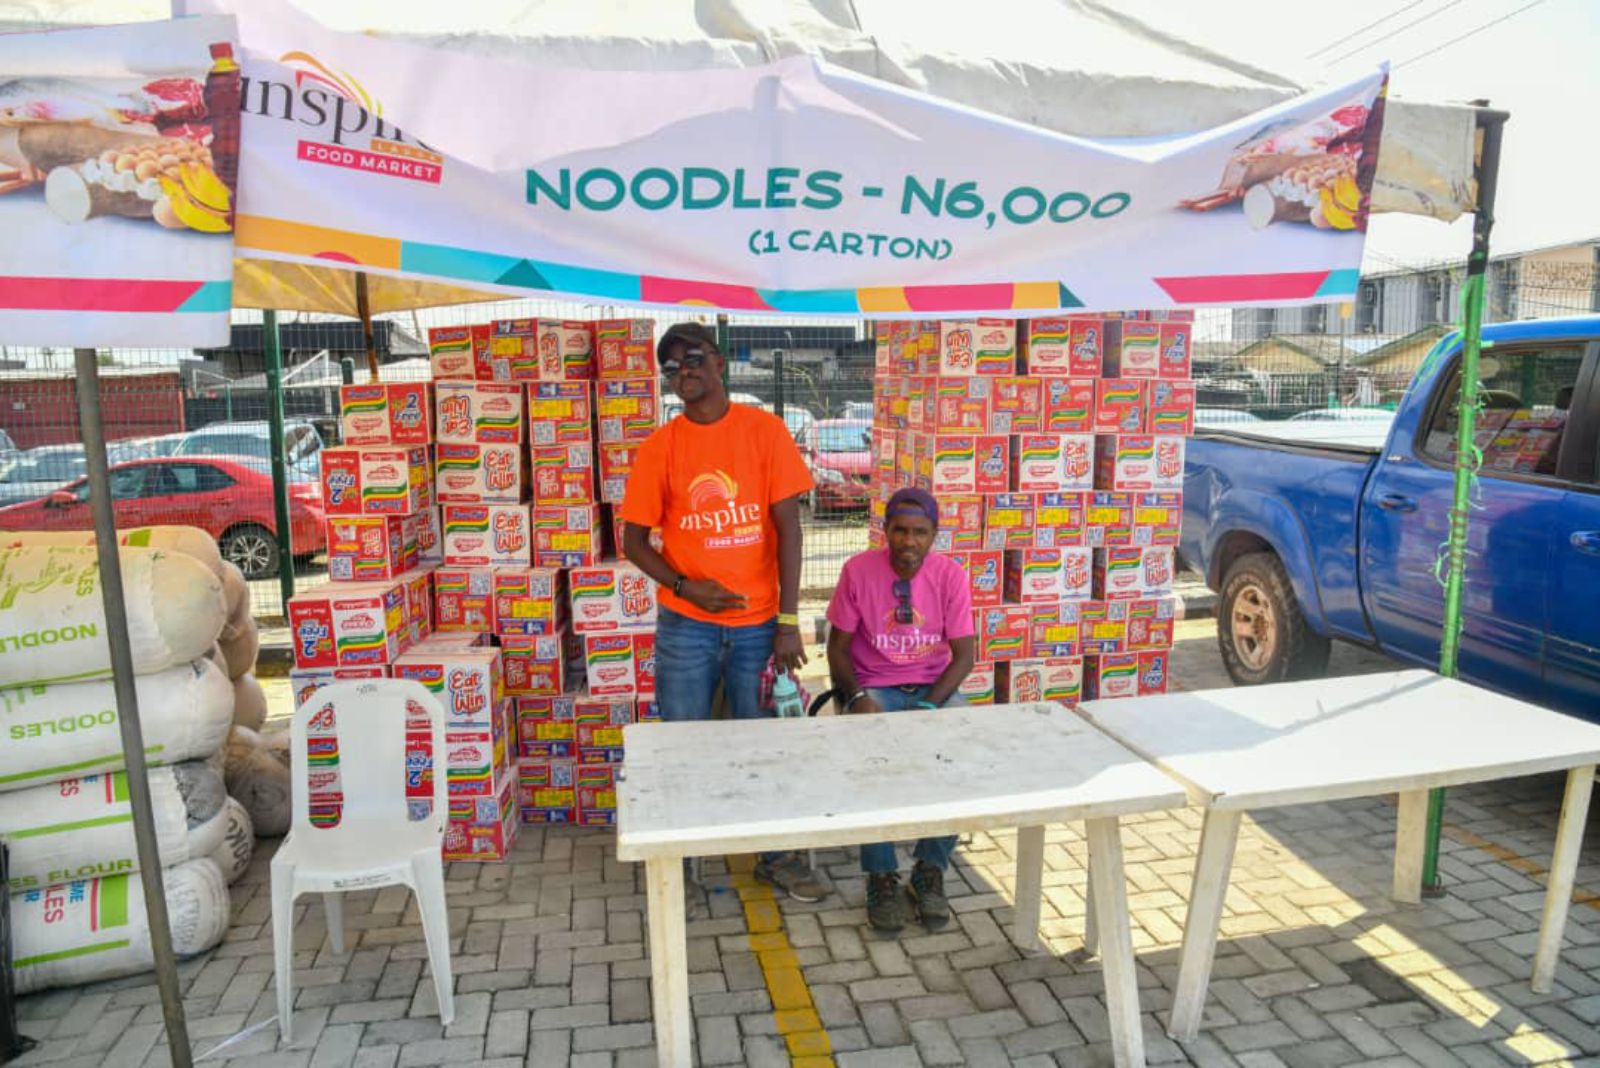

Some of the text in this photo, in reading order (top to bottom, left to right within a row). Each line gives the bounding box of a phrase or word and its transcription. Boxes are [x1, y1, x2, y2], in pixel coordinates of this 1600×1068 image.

[306, 146, 436, 179] FOOD MARKET
[525, 167, 1130, 229] NOODLES - N6,000
[749, 230, 953, 260] (1 CARTON)
[1087, 328, 1096, 344] 2
[1175, 333, 1185, 347] 2
[407, 394, 417, 409] 2
[486, 450, 513, 467] Eat
[495, 511, 520, 529] Eat
[496, 528, 525, 552] Win
[985, 560, 996, 574] 2
[622, 575, 647, 593] Eat
[624, 594, 651, 615] Win
[300, 627, 327, 638] Free
[304, 639, 315, 657] 2
[1151, 657, 1162, 671] 2
[451, 669, 480, 690] Eat
[455, 691, 485, 714] Win
[10, 710, 115, 739] OODLES
[409, 770, 420, 786] 2
